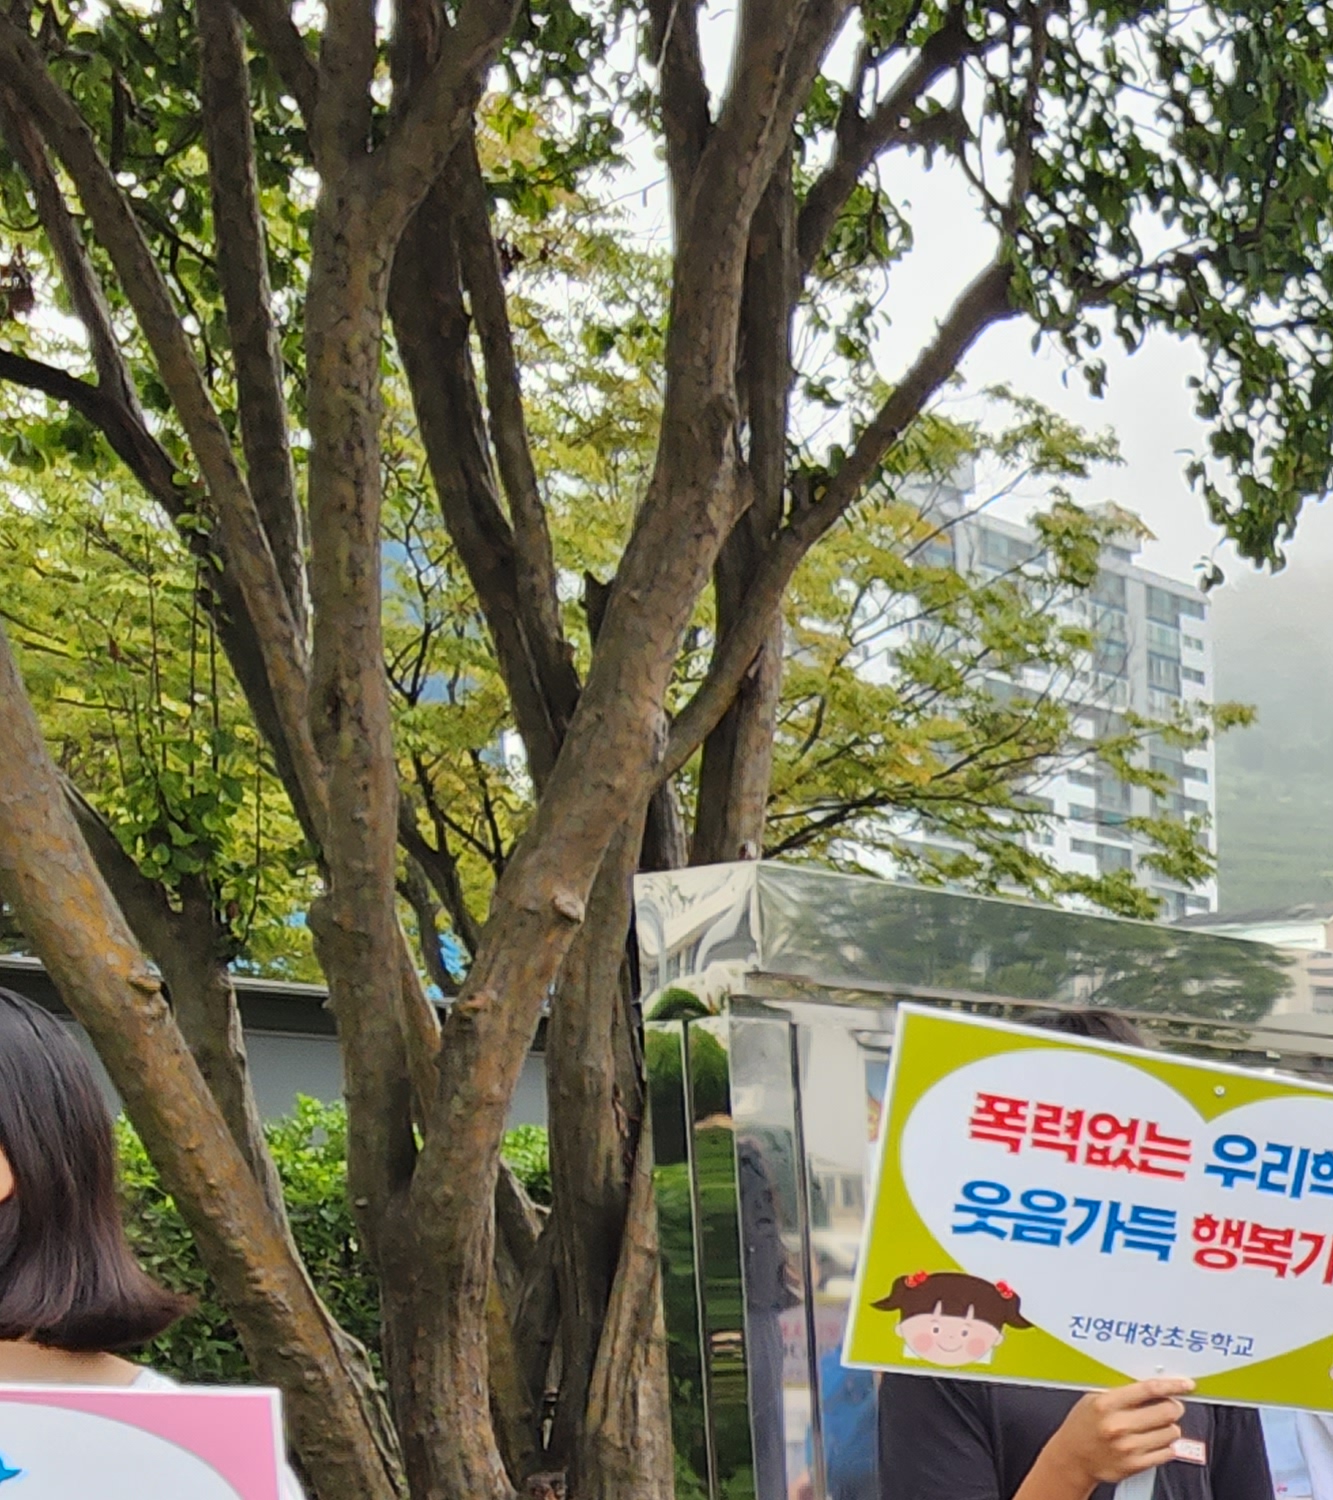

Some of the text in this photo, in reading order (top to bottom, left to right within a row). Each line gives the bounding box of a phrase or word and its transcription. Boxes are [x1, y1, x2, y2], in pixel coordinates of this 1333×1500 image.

[968, 1091, 1191, 1181] 폭력없는
[951, 1180, 1177, 1262] 웃음가득
[1069, 1315, 1255, 1358] 진영대창초등학교
